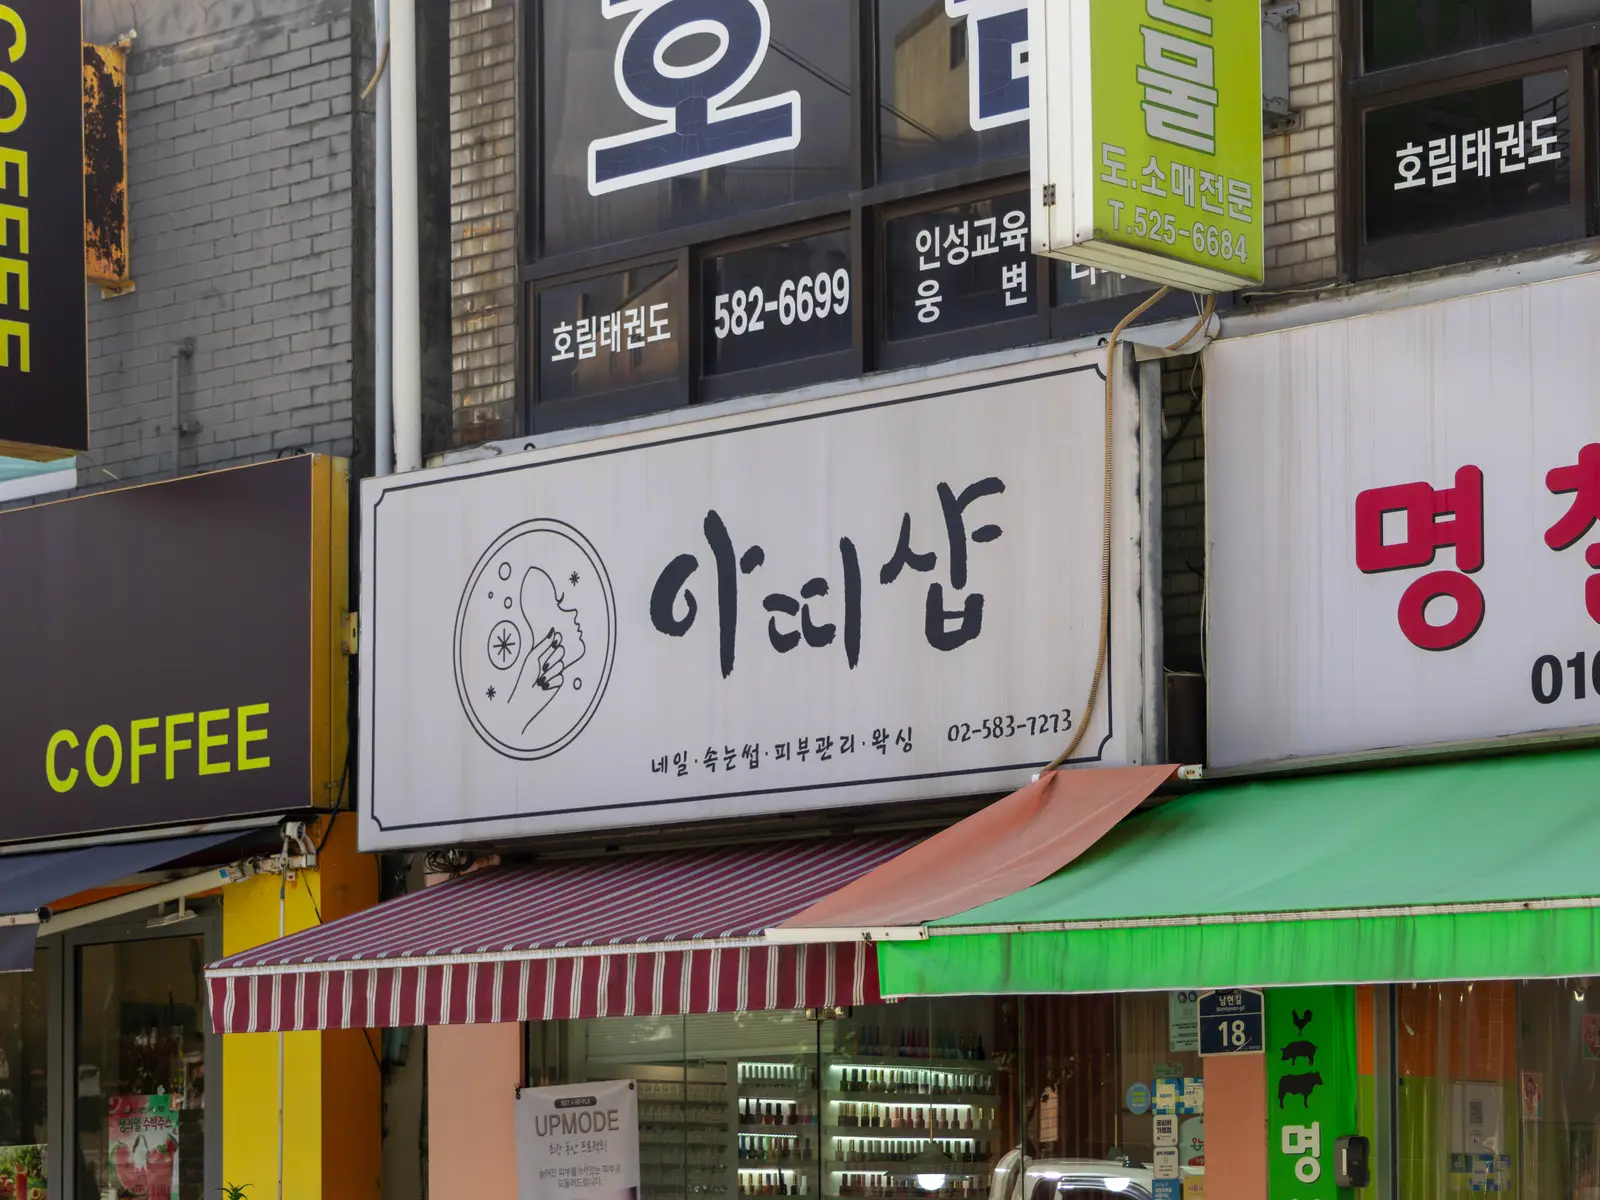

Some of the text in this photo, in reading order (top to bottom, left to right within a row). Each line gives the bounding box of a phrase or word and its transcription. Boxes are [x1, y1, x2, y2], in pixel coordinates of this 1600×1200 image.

[1394, 115, 1562, 191] 호림태권도
[915, 210, 1029, 272] 인성교육
[1107, 198, 1248, 265] T.525-6684
[551, 302, 671, 362] 호림태권도
[714, 267, 850, 339] 582-6699
[1531, 651, 1600, 704] 01
[45, 702, 271, 793] COFFEE
[947, 708, 1072, 742] 02-583-7273
[1217, 1020, 1246, 1047] 18
[535, 1109, 620, 1137] UPMODE
[1281, 1121, 1321, 1200] 명
